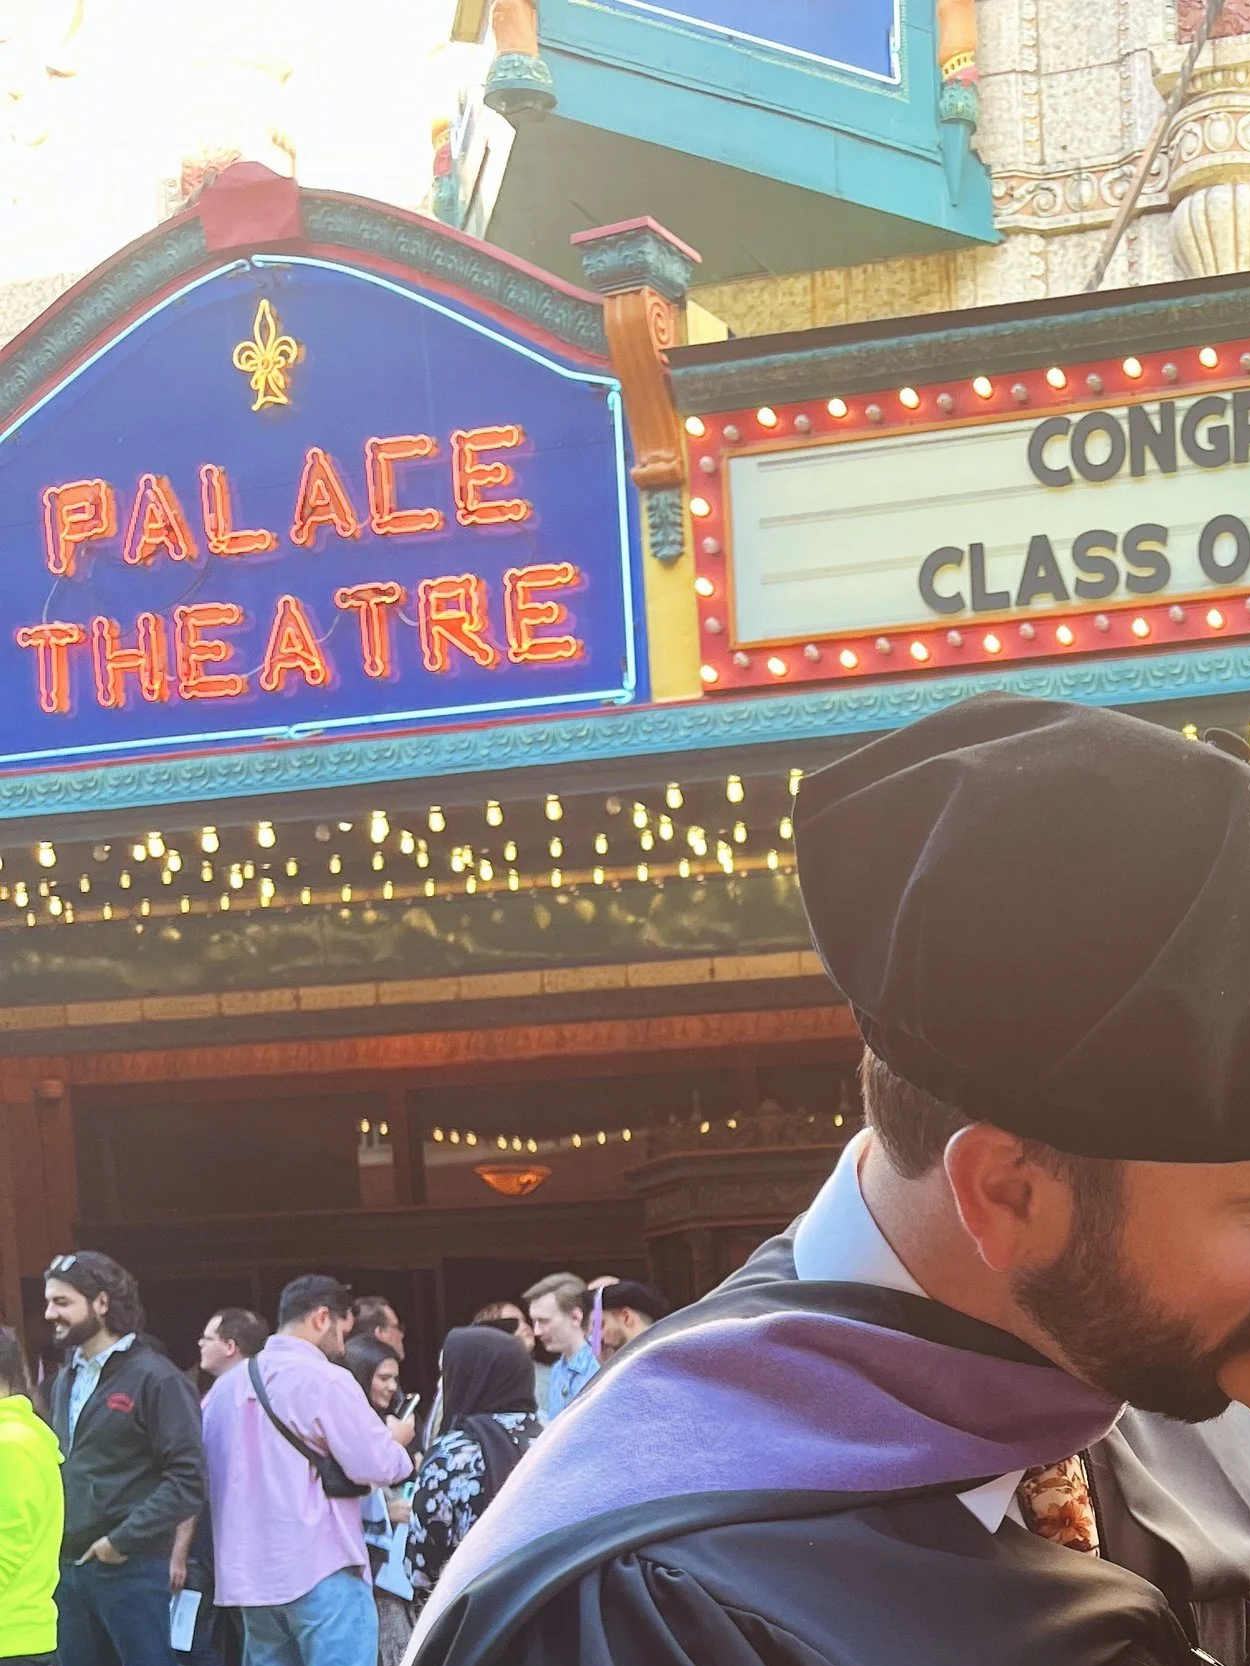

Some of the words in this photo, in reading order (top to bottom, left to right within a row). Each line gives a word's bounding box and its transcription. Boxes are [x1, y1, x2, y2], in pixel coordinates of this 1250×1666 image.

[43, 424, 532, 575] PALACE
[919, 523, 1171, 615] CLASS
[16, 562, 584, 713] THEATRE
